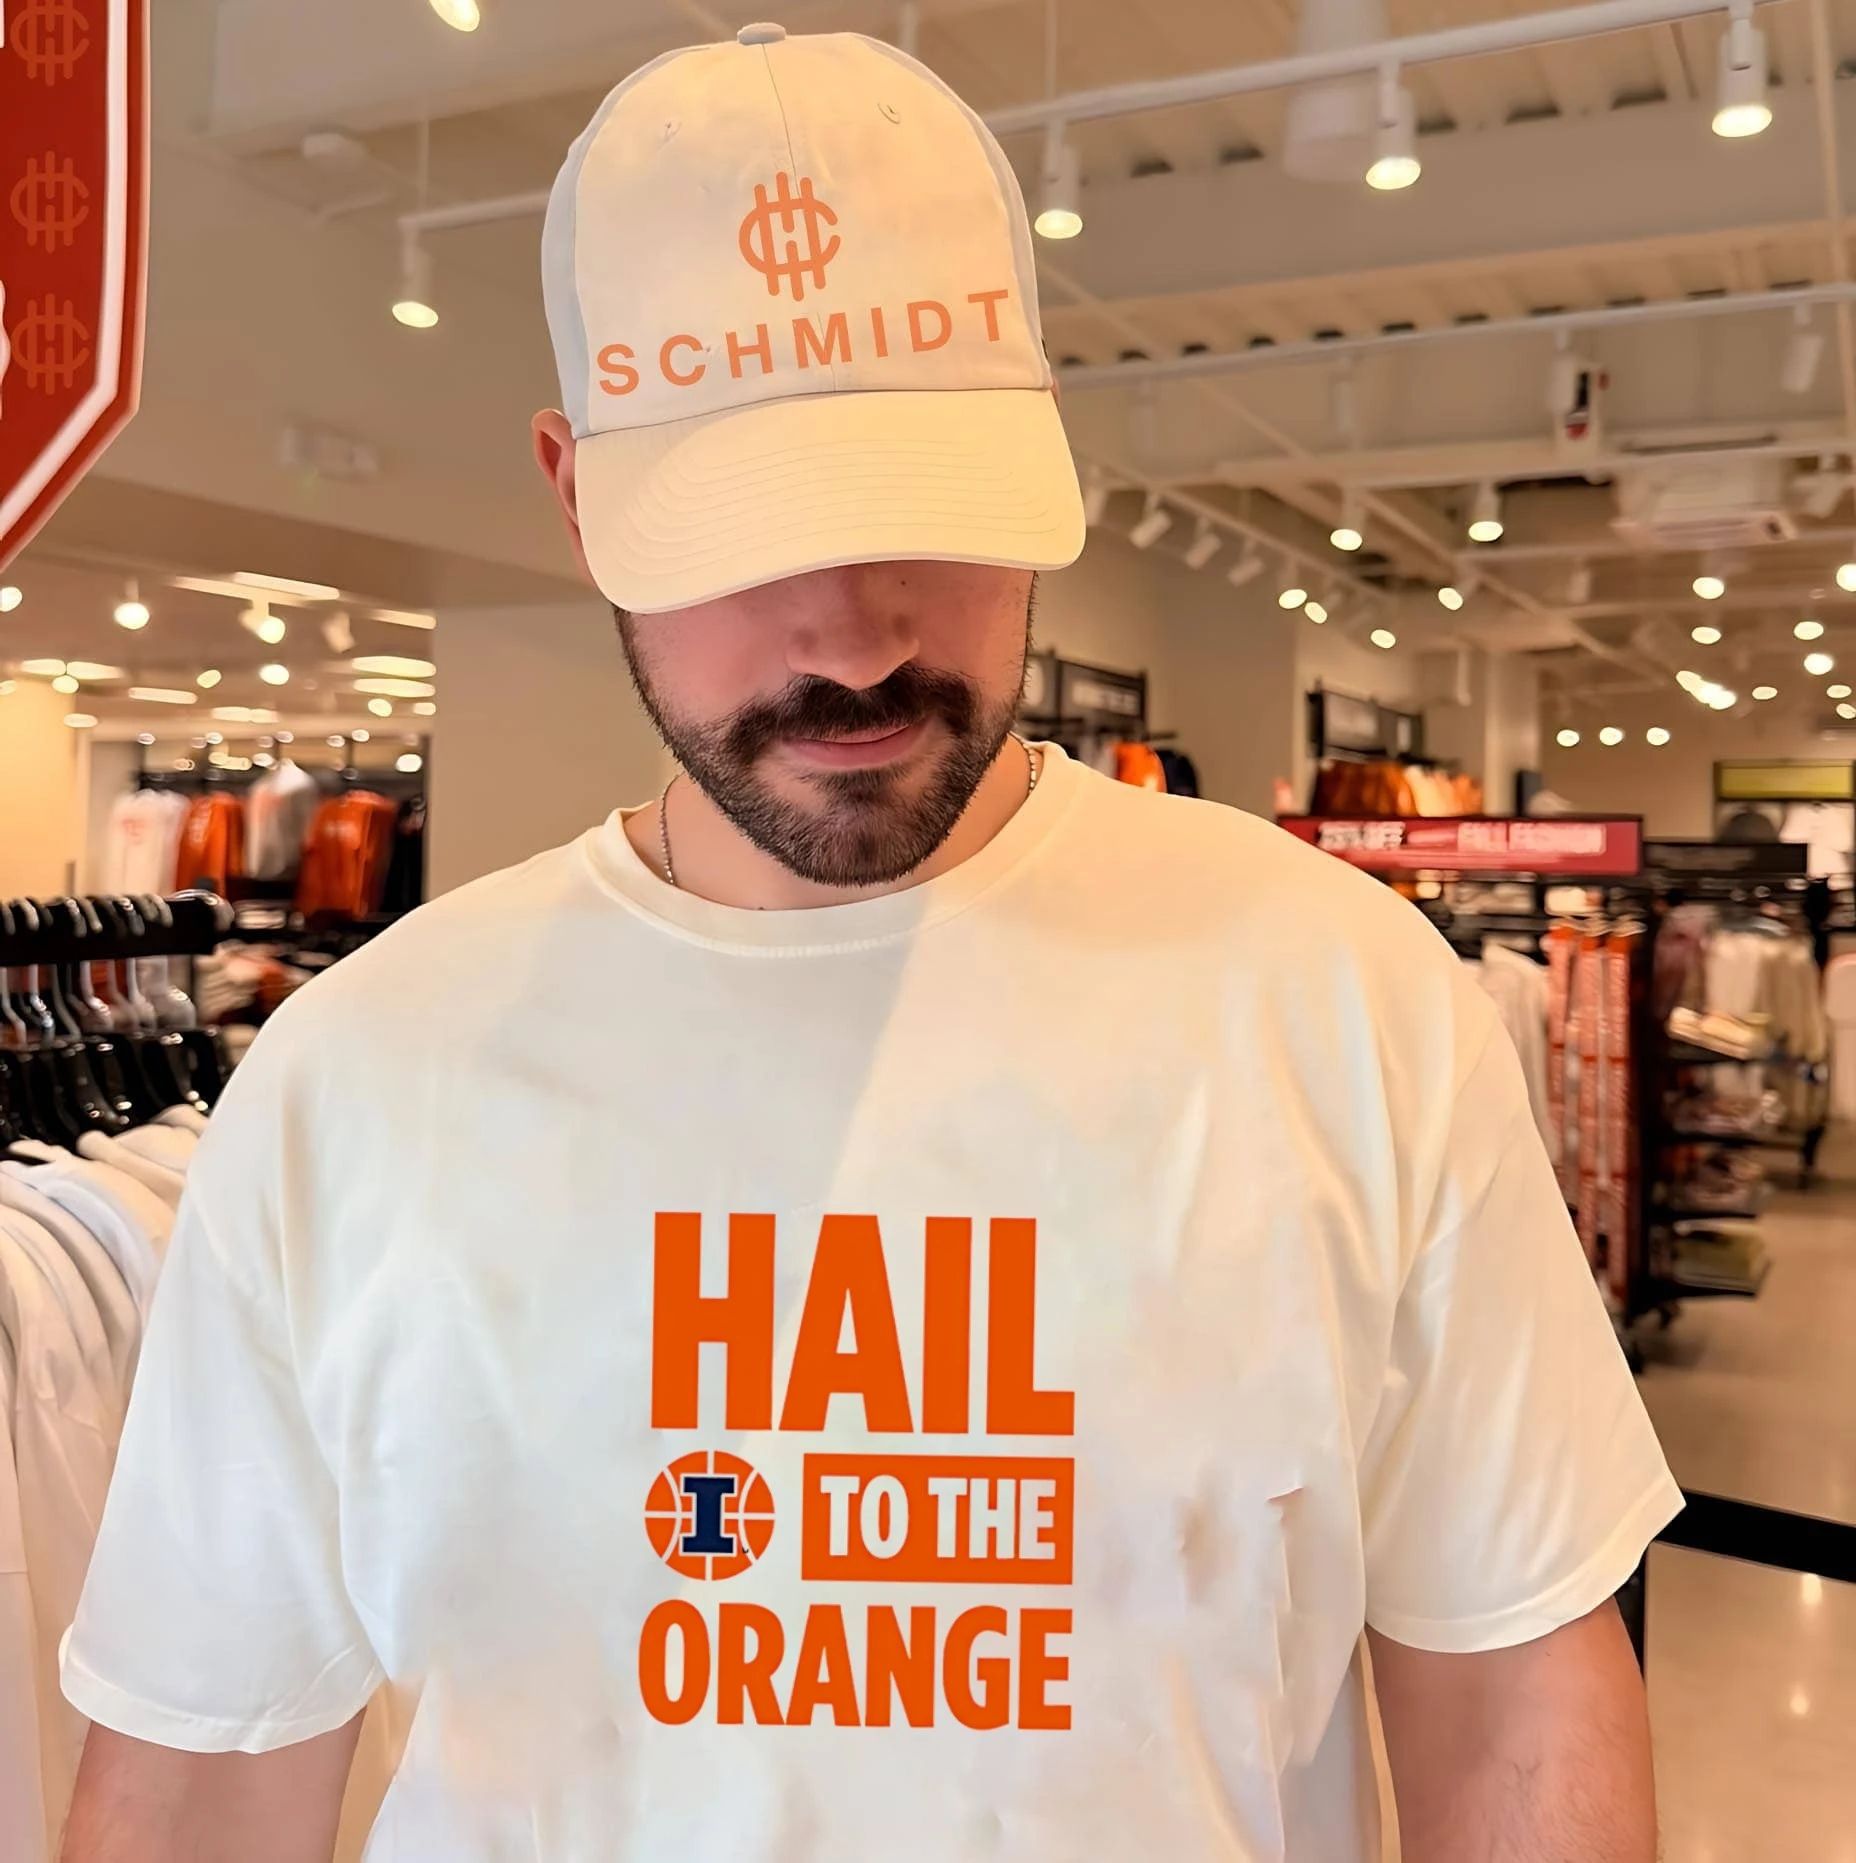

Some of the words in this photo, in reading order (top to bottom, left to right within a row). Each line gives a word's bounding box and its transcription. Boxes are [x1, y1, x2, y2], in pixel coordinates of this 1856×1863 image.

[597, 289, 1009, 396] SCHMIDT
[651, 1211, 1076, 1436] HAIL
[680, 1474, 737, 1556] I
[820, 1475, 908, 1559] TO
[928, 1477, 1056, 1559] THE
[638, 1599, 1073, 1732] ORANGE
